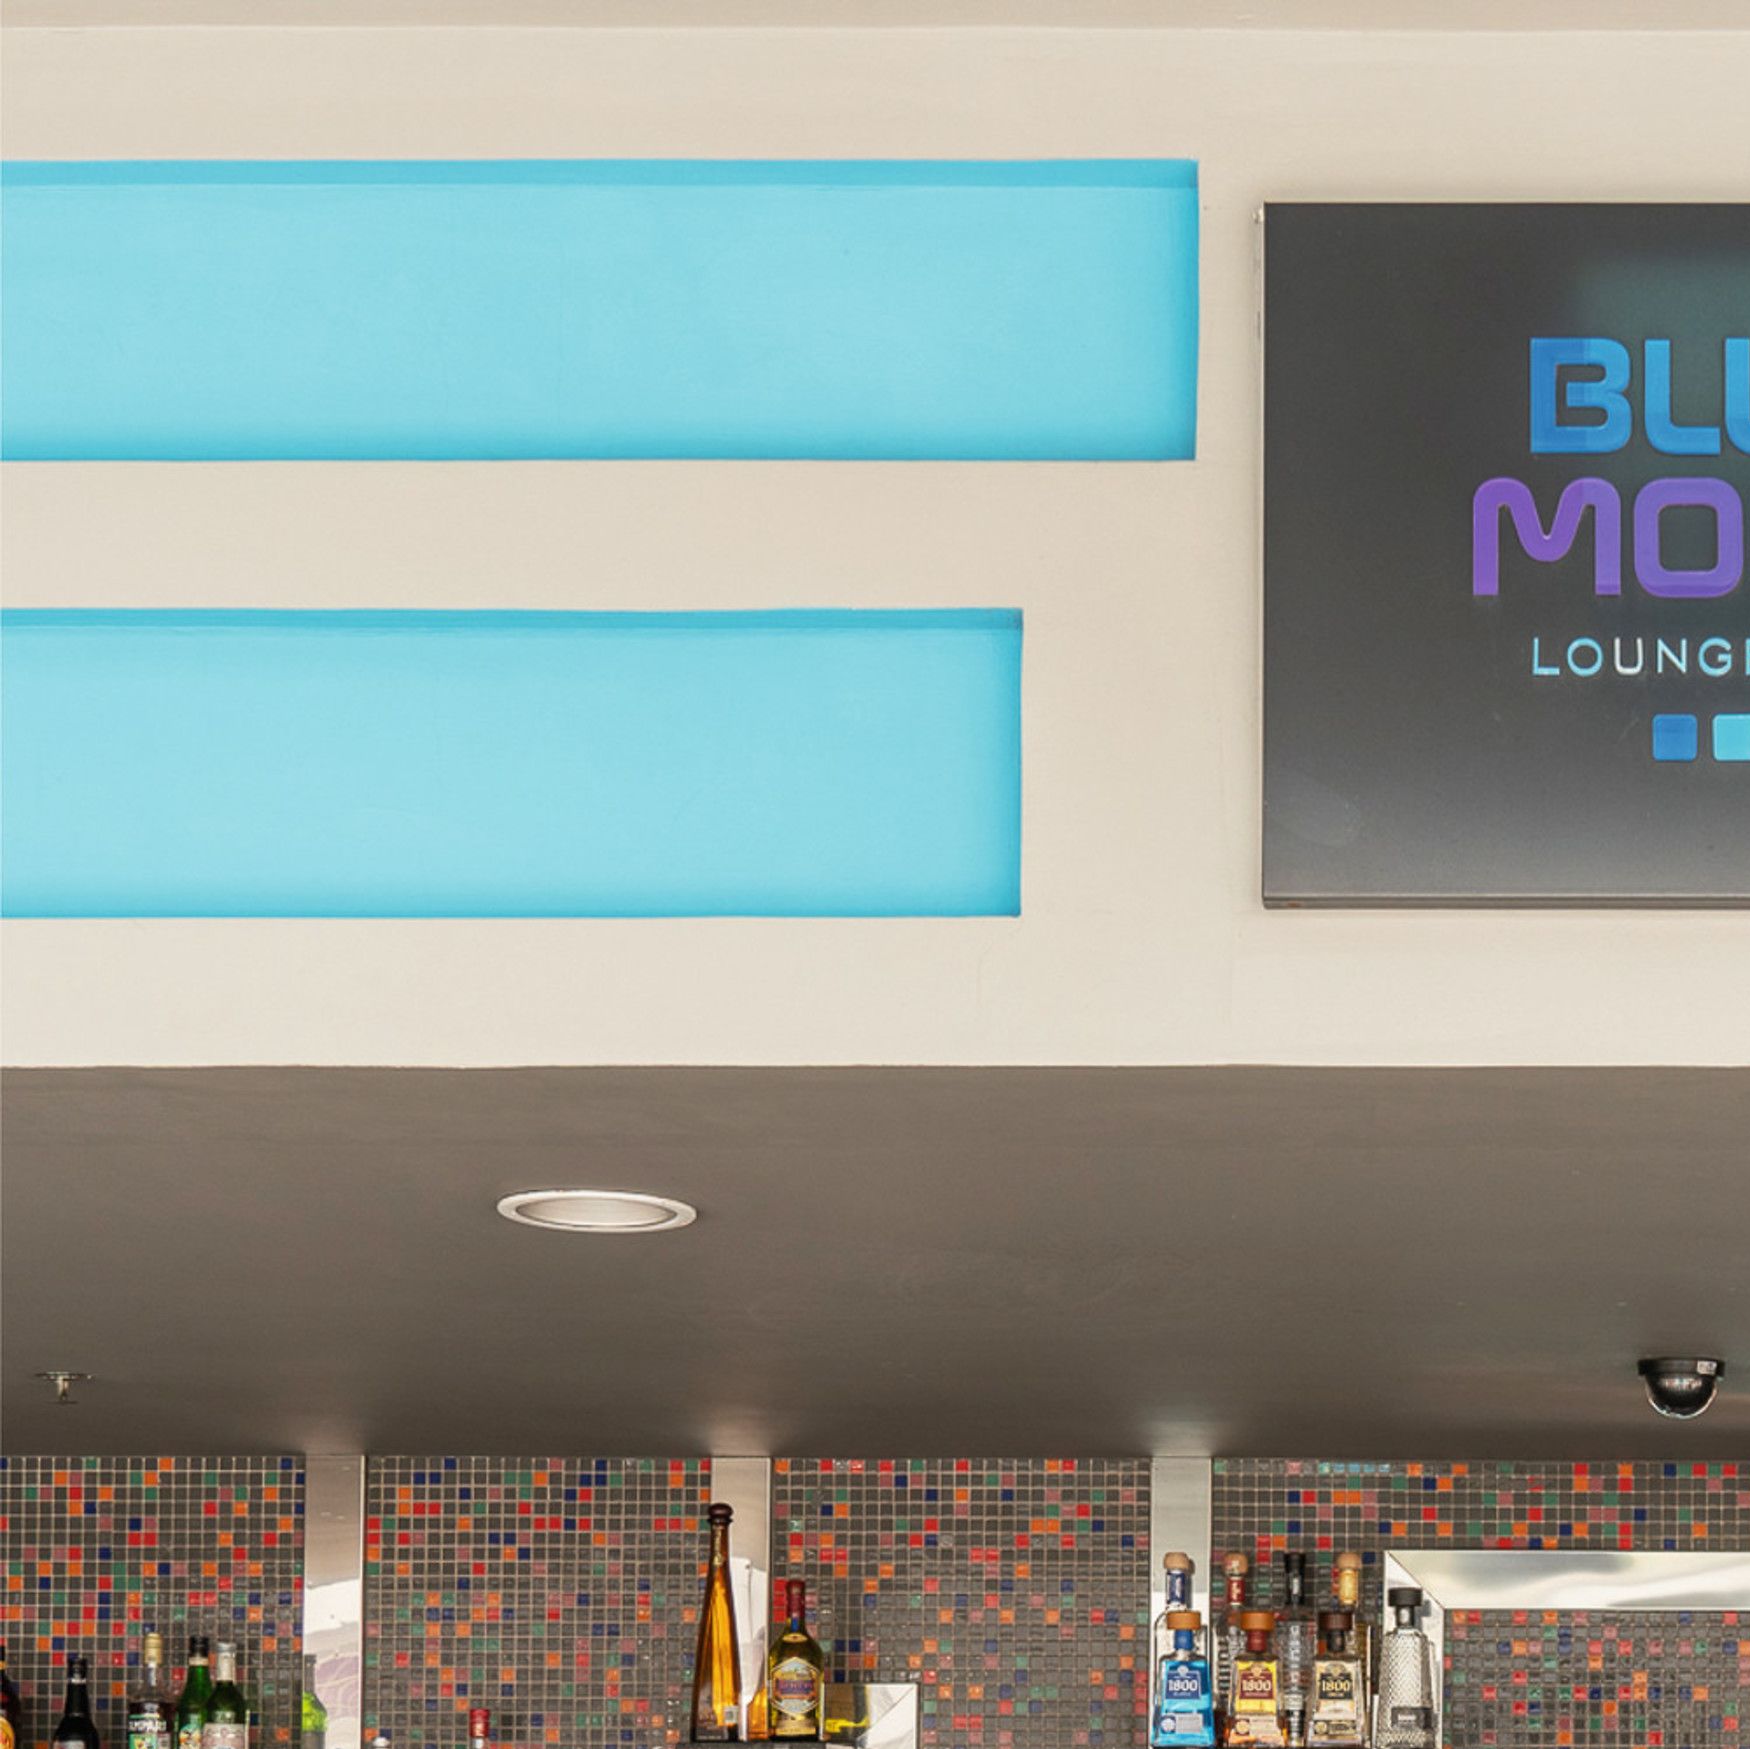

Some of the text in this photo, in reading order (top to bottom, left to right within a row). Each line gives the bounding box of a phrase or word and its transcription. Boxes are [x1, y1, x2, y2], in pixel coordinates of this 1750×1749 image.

[1168, 1679, 1198, 1692] 1800
[1242, 1679, 1272, 1692] 1800
[1321, 1680, 1351, 1692] 1800
